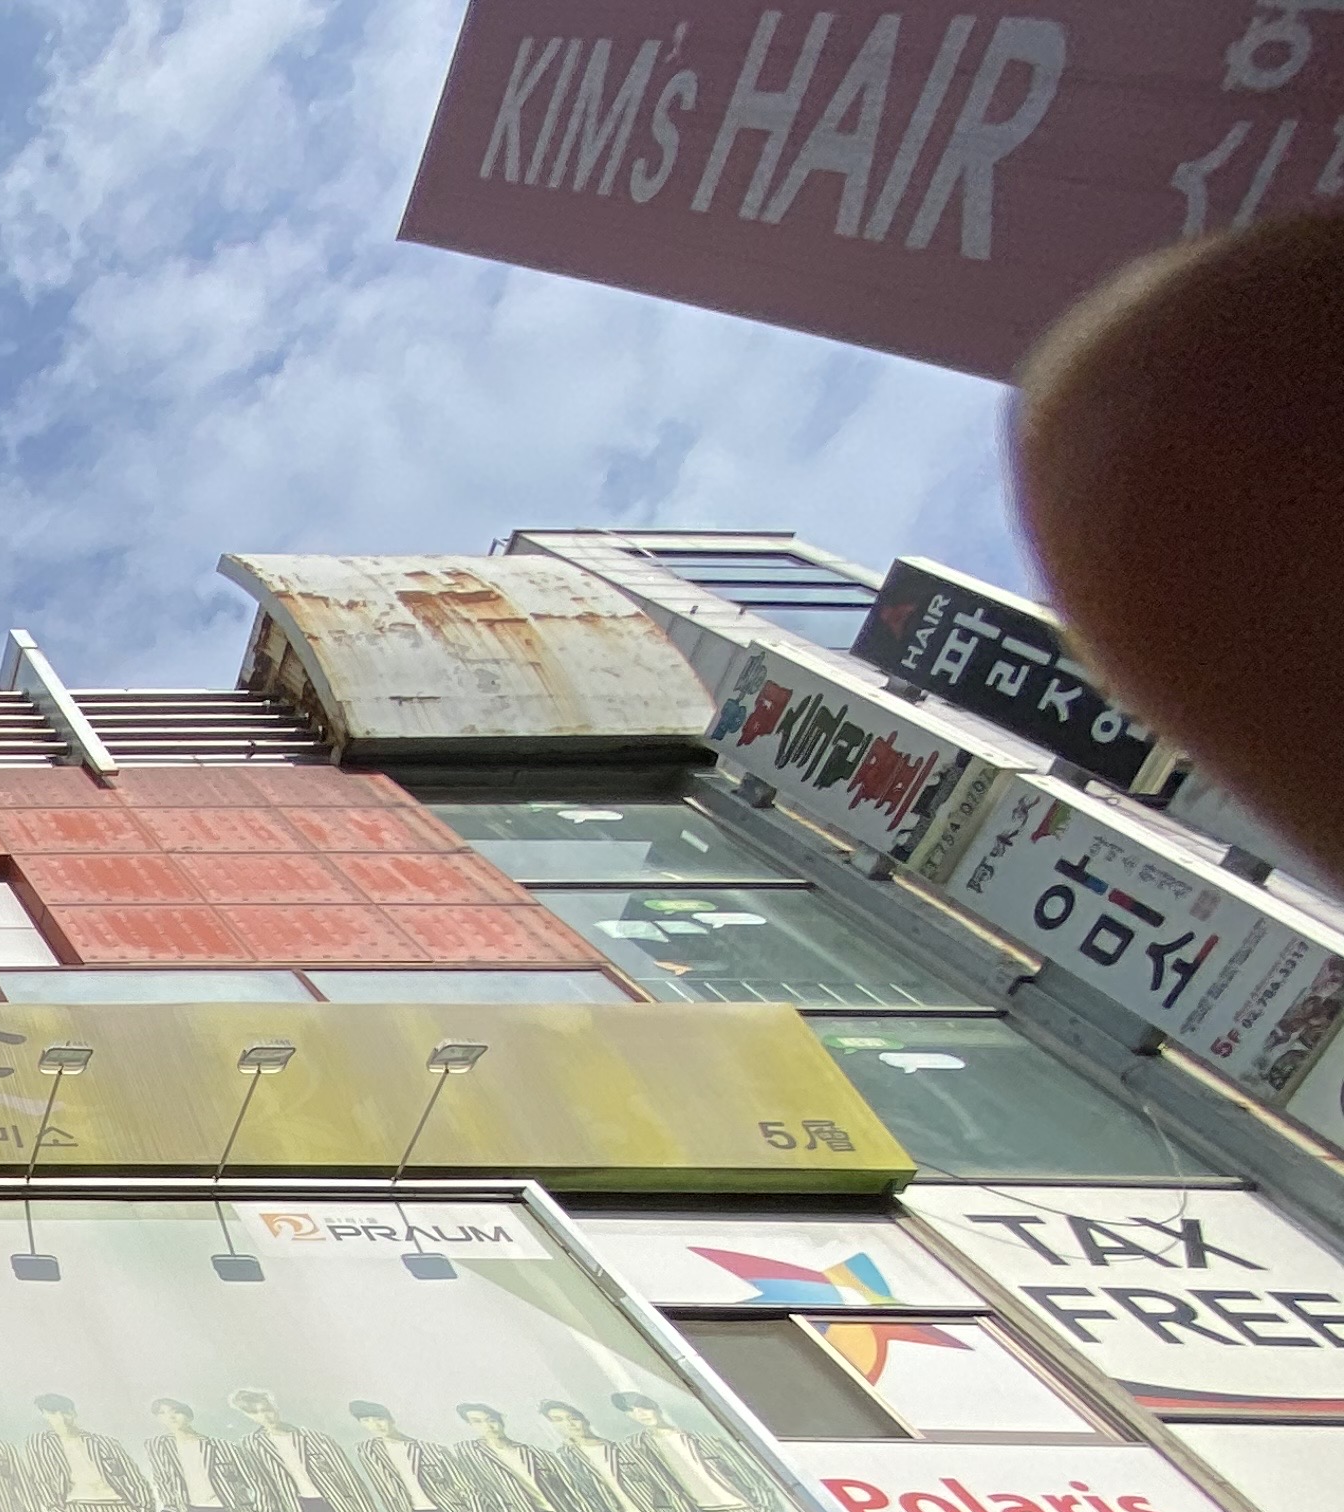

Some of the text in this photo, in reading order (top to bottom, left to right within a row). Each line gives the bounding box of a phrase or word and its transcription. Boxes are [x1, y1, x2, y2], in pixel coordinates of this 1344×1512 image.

[692, 9, 1069, 261] HAIR
[901, 593, 951, 671] HAIR
[1033, 854, 1219, 1010] 아미소
[759, 1120, 858, 1153] 5層
[326, 1225, 514, 1242] PRAUM
[965, 1213, 1269, 1271] TAX
